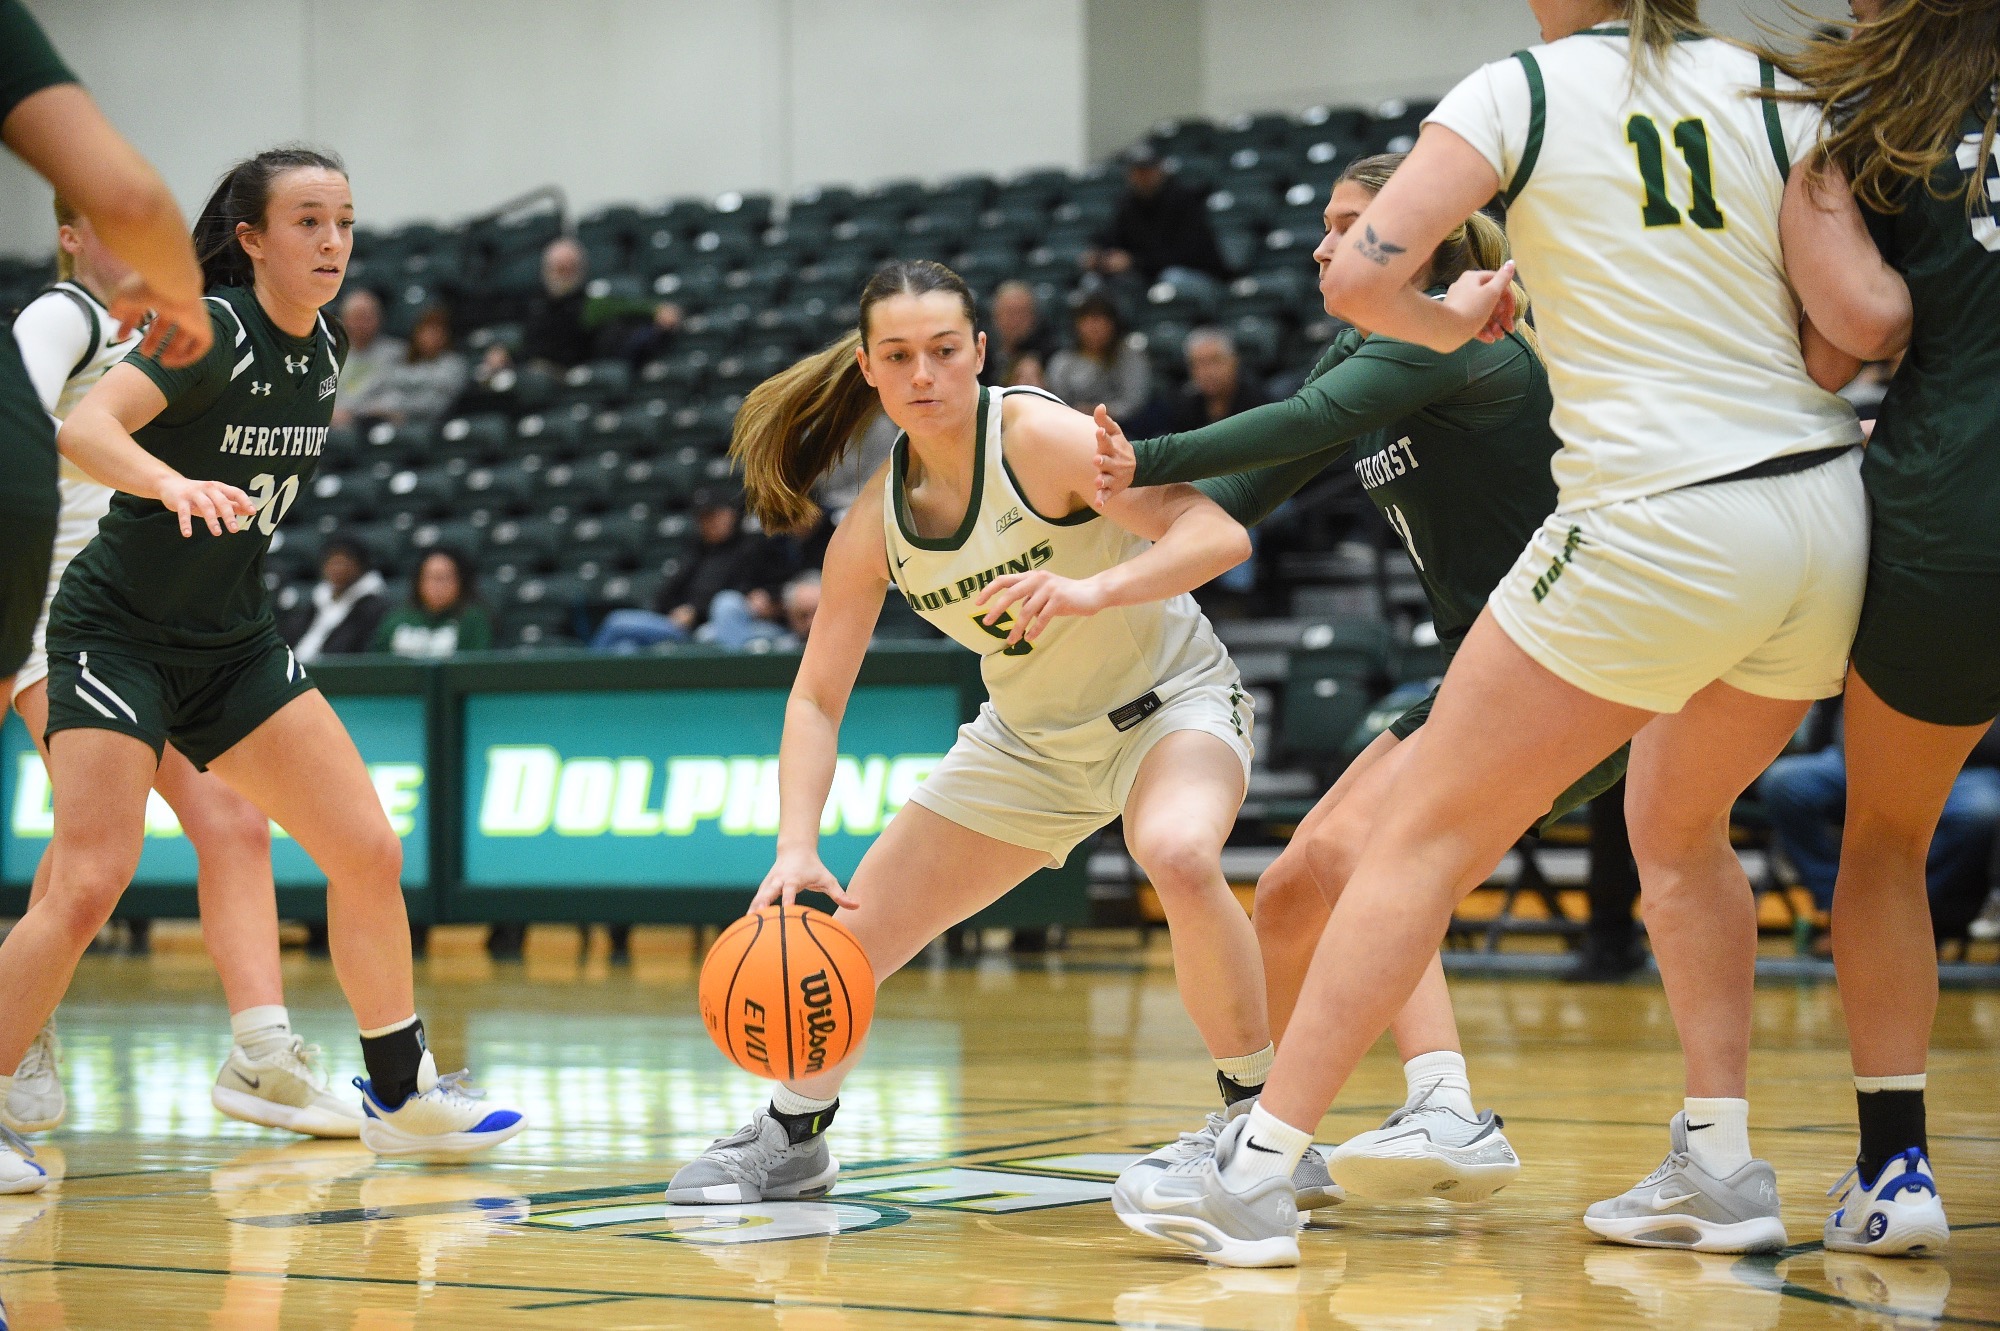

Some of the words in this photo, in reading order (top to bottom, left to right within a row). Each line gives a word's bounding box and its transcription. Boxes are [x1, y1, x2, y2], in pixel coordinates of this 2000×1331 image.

[1625, 112, 1726, 233] 11
[235, 472, 300, 537] 20
[995, 506, 1019, 533] NEC
[1143, 701, 1155, 711] M
[478, 743, 945, 837] DOLPHNS
[743, 997, 770, 1065] EVO
[799, 968, 837, 1076] Wilson
